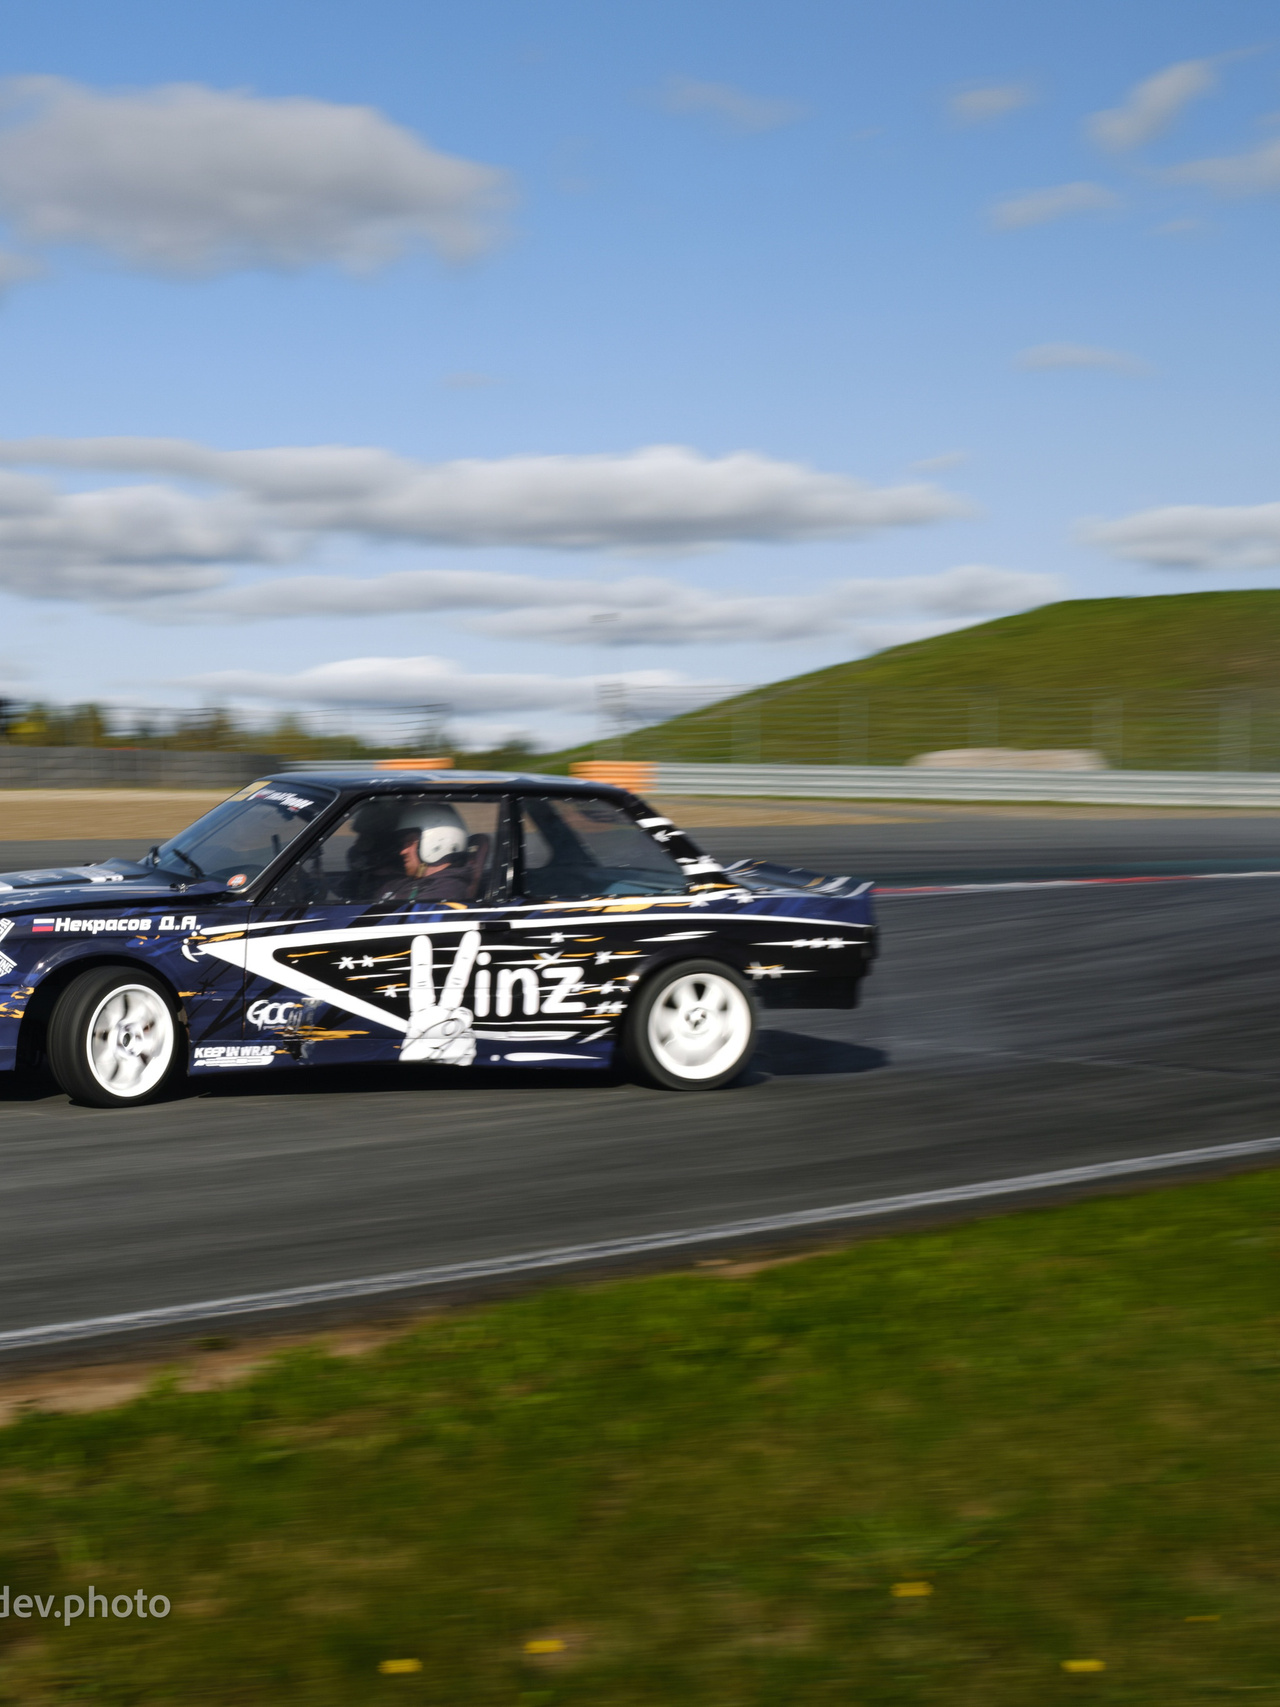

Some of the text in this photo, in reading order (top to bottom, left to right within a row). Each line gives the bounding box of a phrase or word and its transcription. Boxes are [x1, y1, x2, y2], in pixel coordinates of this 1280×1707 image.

[54, 915, 202, 935] Некрасов Д.А.
[194, 1045, 276, 1058] KEEP IN WRAP
